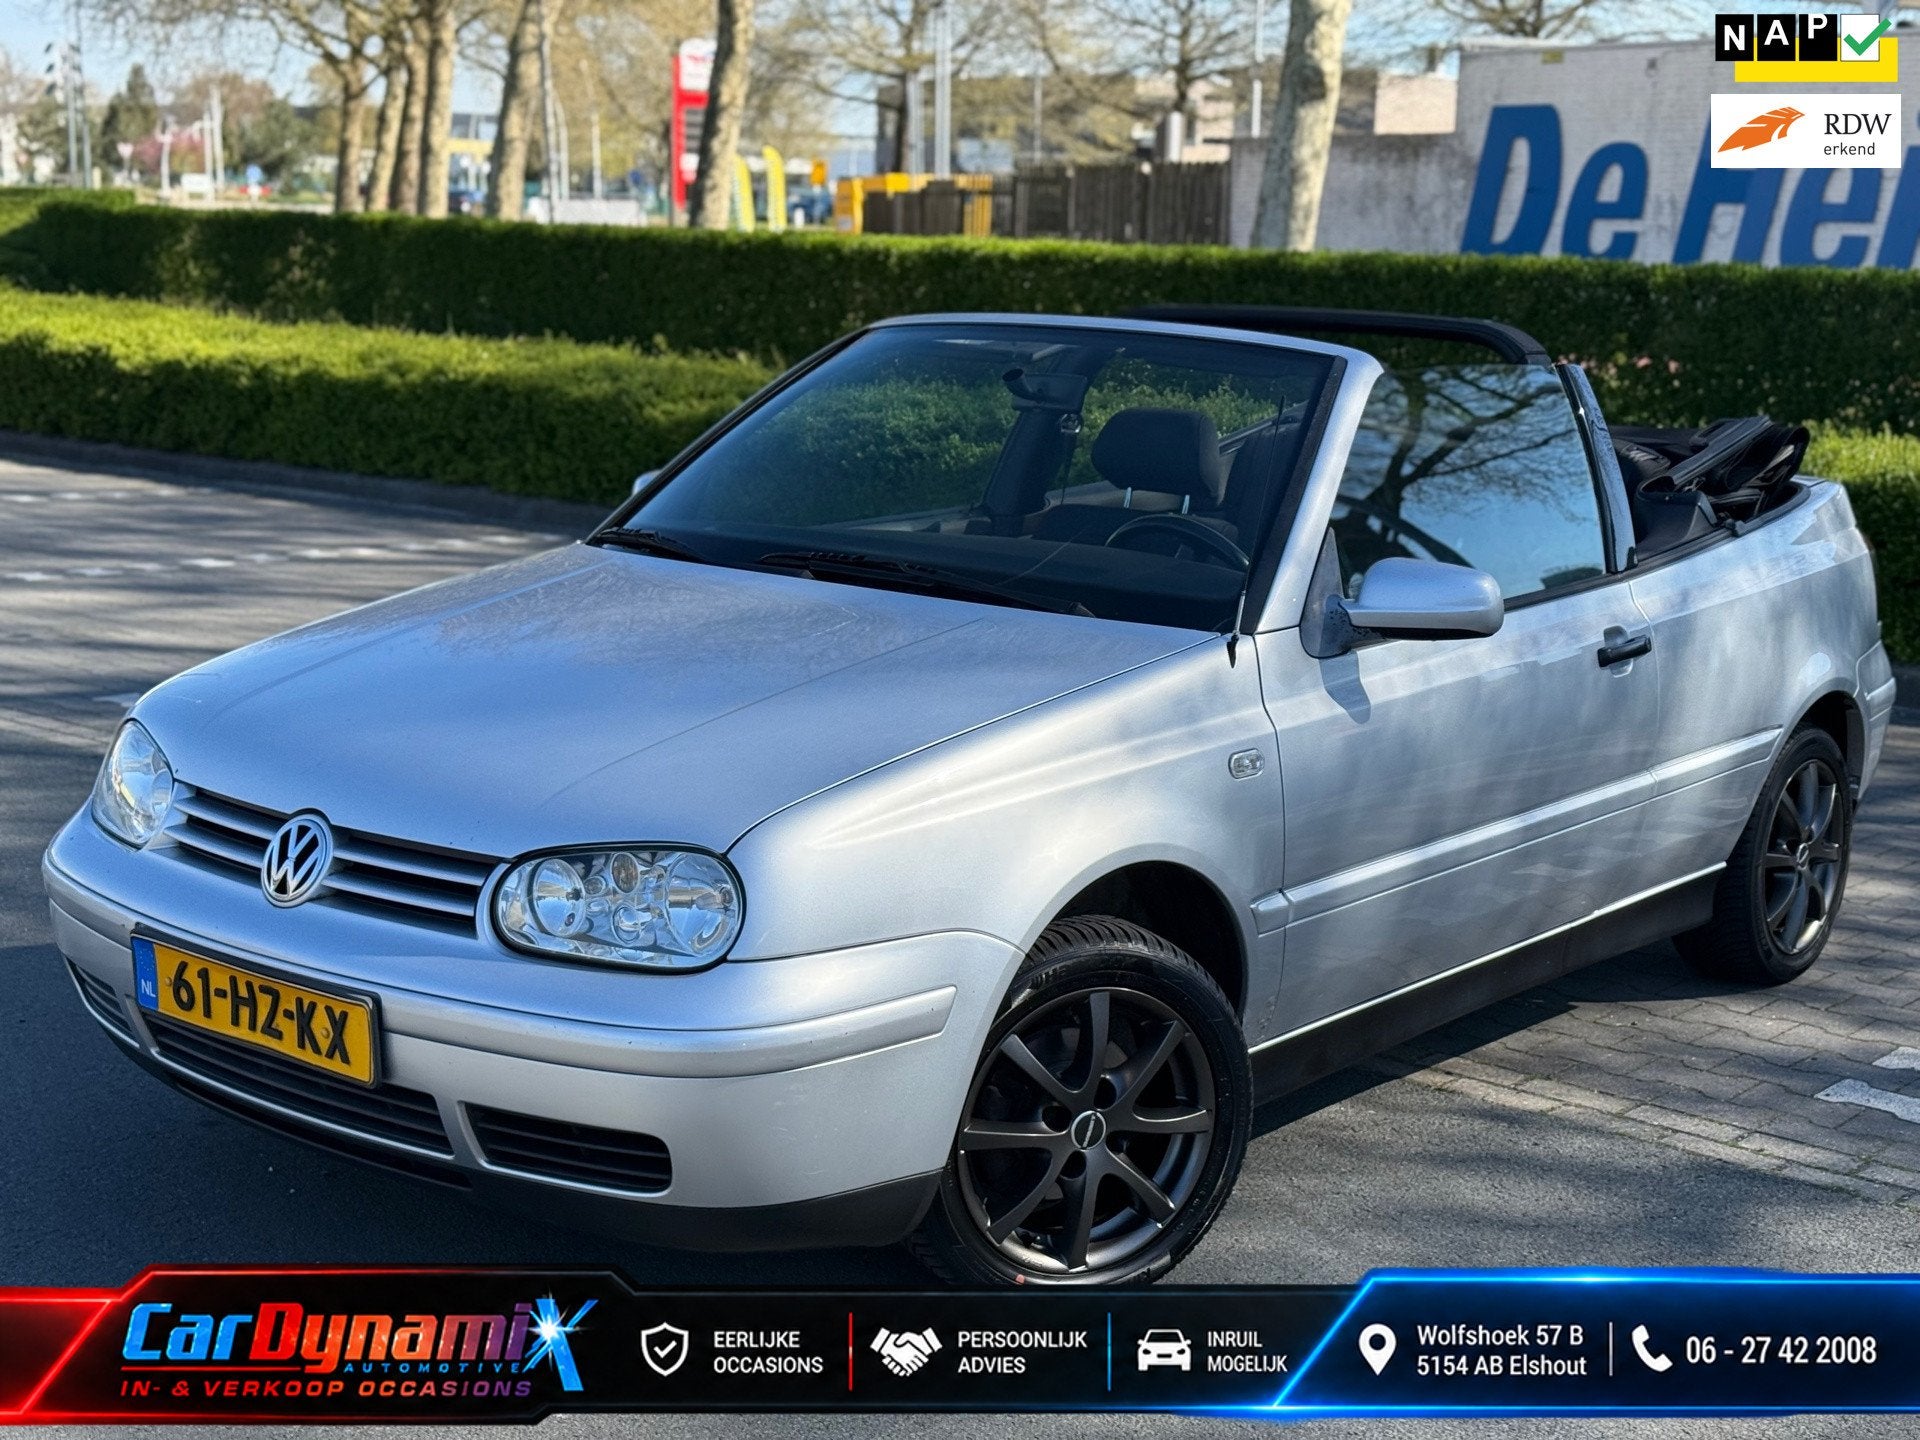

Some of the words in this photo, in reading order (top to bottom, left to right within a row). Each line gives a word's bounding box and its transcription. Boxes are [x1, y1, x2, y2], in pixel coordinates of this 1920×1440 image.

[1460, 104, 1649, 260] De
[263, 815, 334, 905] VW
[141, 978, 156, 998] NL
[171, 960, 351, 1066] 61-HZ-KX
